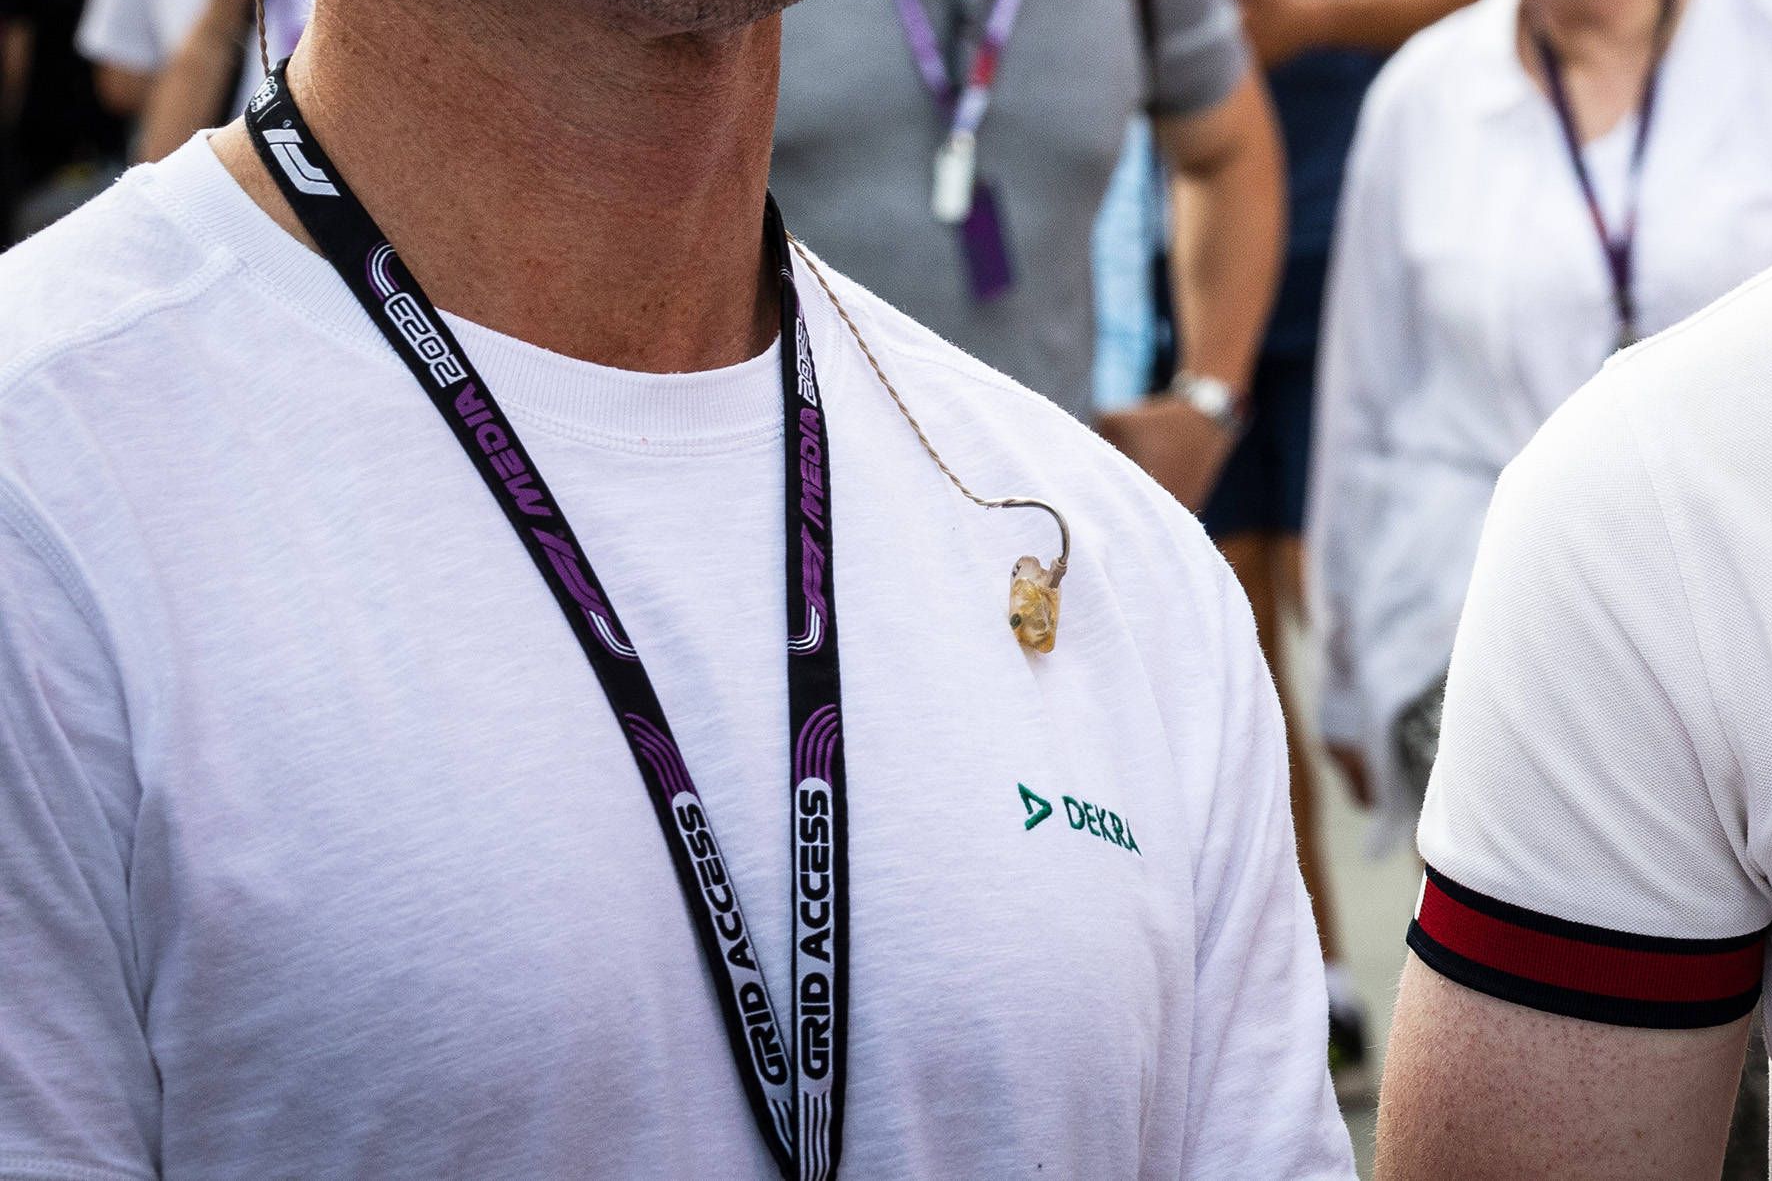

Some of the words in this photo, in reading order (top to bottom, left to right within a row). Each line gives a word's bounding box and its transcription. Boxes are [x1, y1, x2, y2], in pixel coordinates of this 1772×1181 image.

[384, 292, 467, 388] 2023
[454, 382, 552, 517] MEDIA
[799, 408, 826, 530] MEDIA
[799, 789, 830, 962] ACCESS
[1062, 795, 1143, 857] DEKRA
[675, 803, 758, 972] ACCESS
[738, 980, 788, 1086] GRID
[800, 971, 831, 1081] GRID
